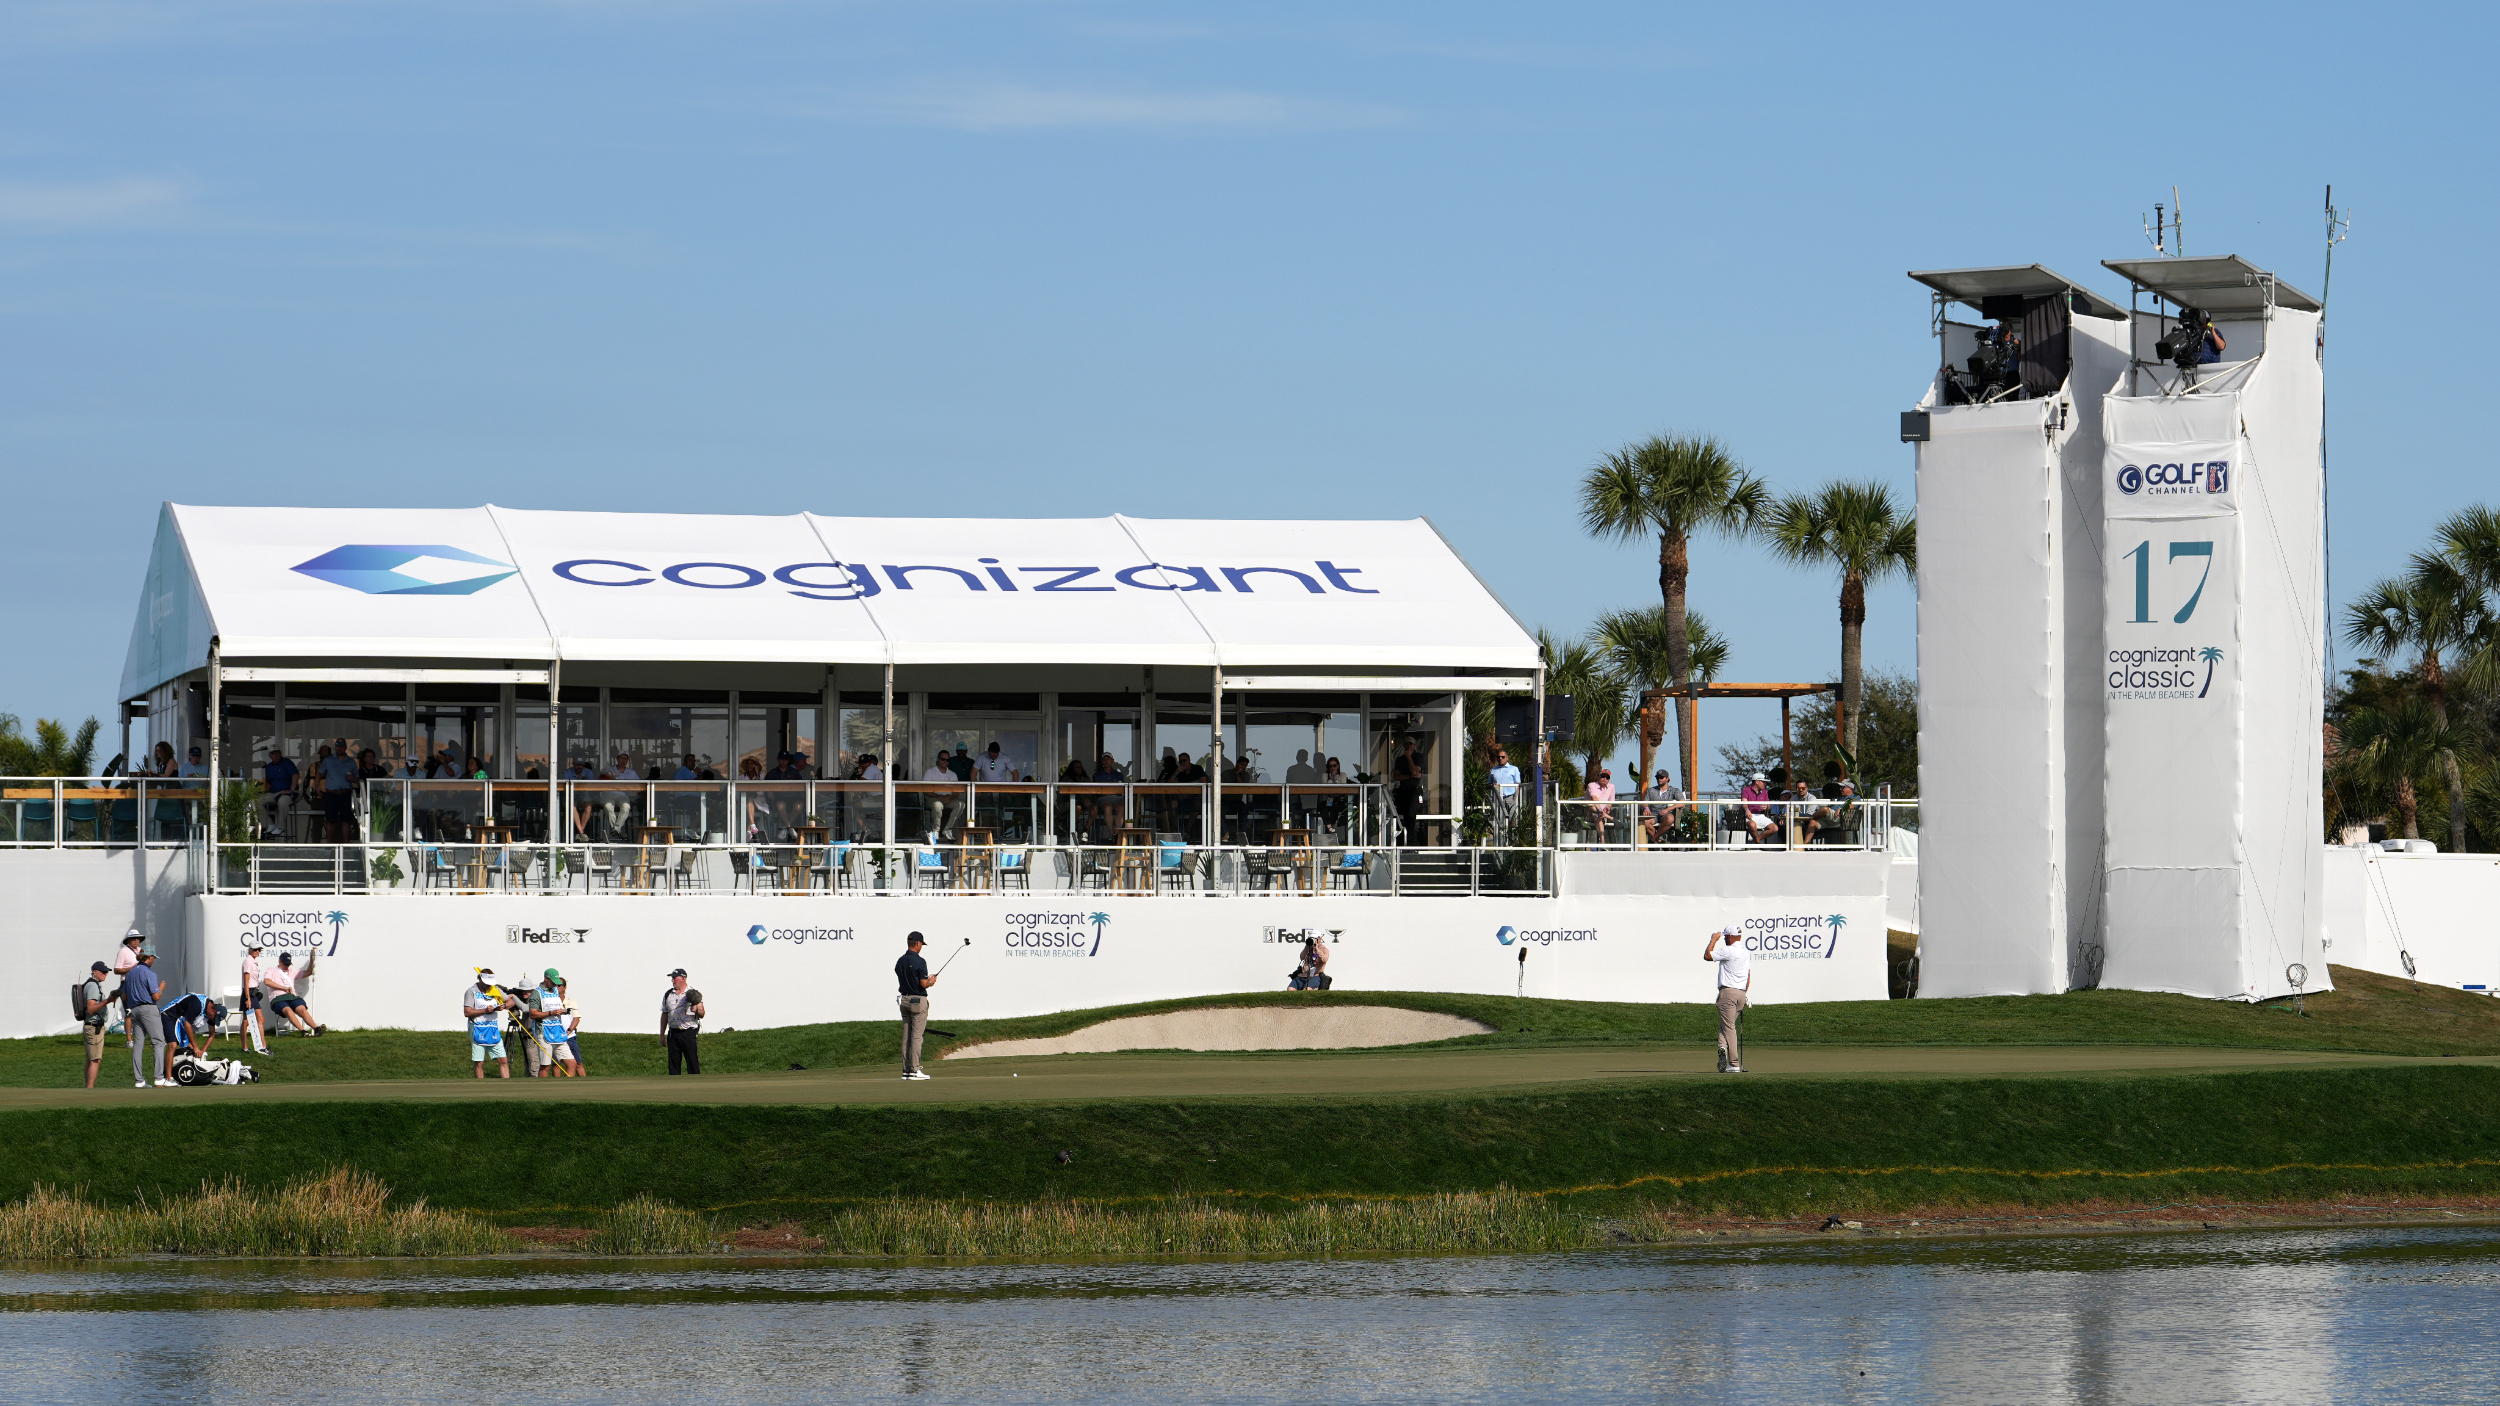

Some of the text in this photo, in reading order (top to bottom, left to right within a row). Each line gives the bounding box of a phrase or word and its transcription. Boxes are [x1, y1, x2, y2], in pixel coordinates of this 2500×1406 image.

[2145, 463, 2205, 485] GOLF
[2148, 486, 2201, 494] CHANNEL
[551, 557, 1380, 600] cognizant
[2122, 540, 2214, 624] 17
[2109, 646, 2196, 668] cognizant
[2109, 663, 2195, 688] classic
[2107, 690, 2195, 700] IN THE PALM BEACHES
[239, 910, 323, 929] cognizant
[1005, 910, 1086, 929] cognizant
[1744, 914, 1823, 934] cognizant
[240, 925, 323, 948] classic
[522, 928, 571, 943] FedEx
[772, 926, 854, 945] cognizant
[1005, 925, 1086, 948] classic
[1520, 927, 1598, 946] cognizant
[1745, 929, 1822, 951] classic
[1754, 953, 1767, 961] THE
[1768, 952, 1788, 960] PALM
[1790, 951, 1822, 959] BEACHES
